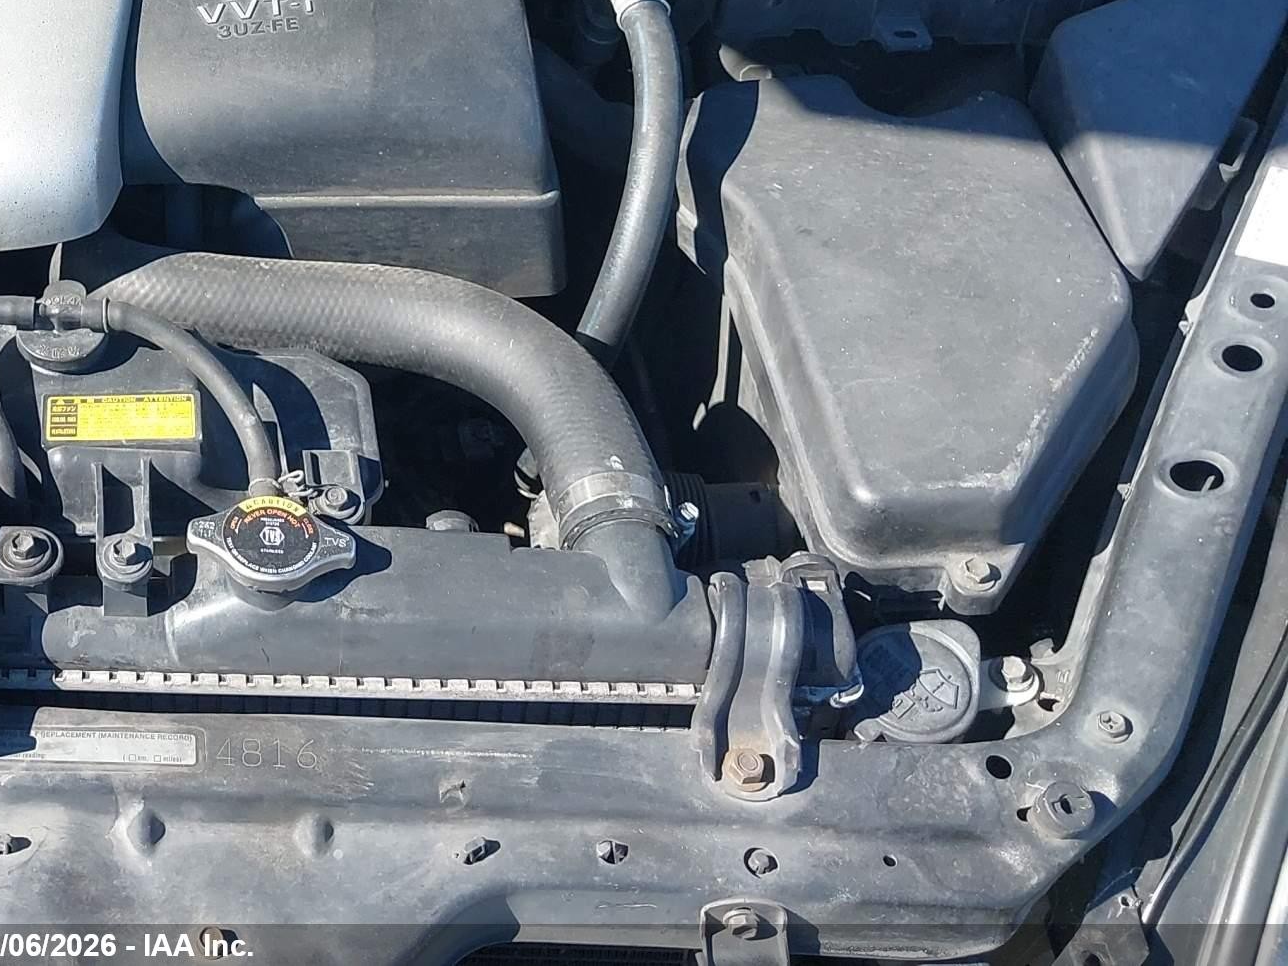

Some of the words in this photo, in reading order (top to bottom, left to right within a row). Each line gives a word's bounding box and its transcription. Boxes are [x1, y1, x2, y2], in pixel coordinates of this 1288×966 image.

[218, 17, 299, 39] 3UZ-FE
[253, 498, 300, 513] CAUTION
[243, 509, 266, 524] NEVER
[266, 508, 287, 518] OPEN
[324, 537, 347, 548] TVS
[236, 554, 259, 571] REPLACE
[216, 738, 319, 769] 4816
